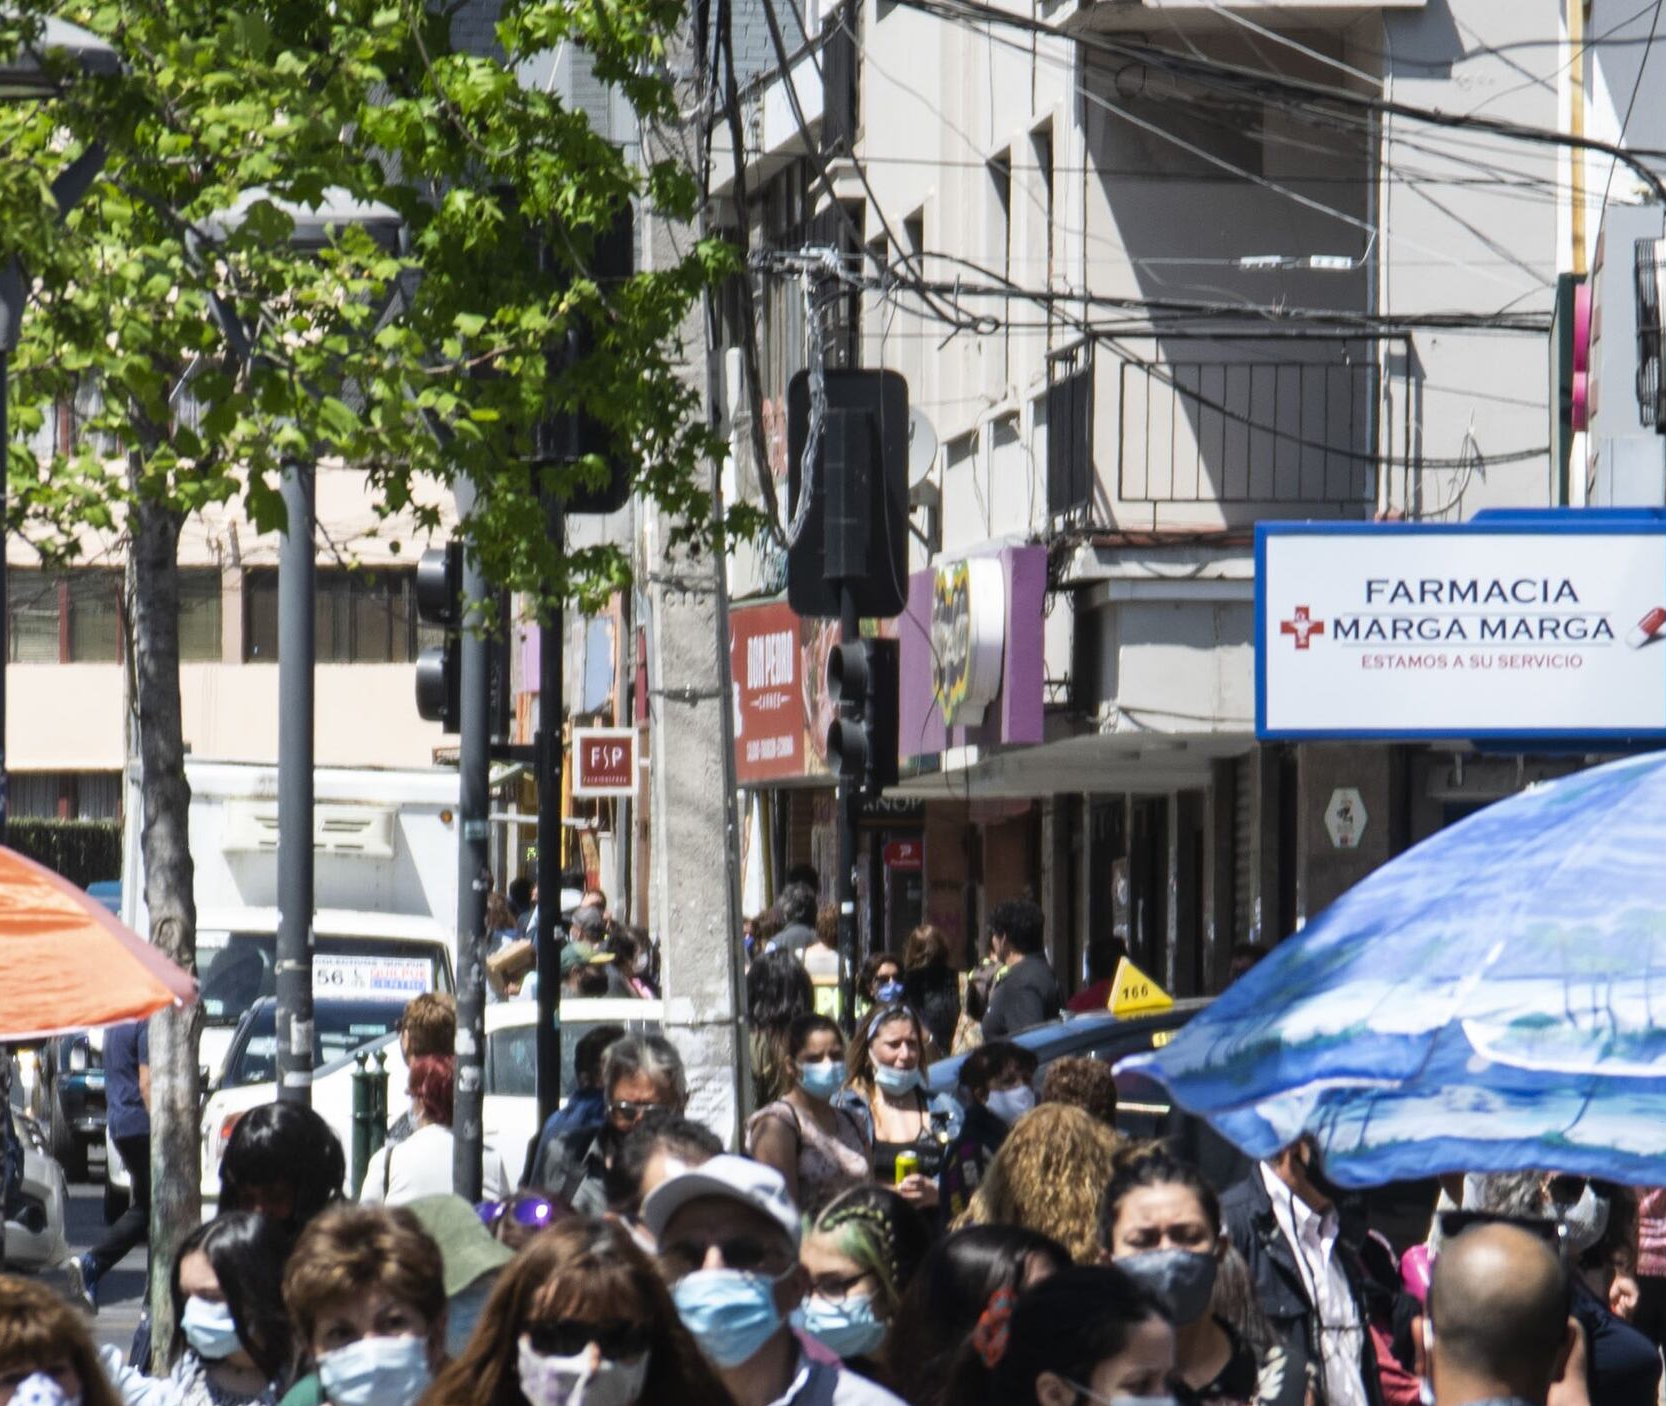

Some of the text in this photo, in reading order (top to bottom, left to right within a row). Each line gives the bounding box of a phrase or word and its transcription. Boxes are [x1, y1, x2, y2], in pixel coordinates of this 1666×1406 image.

[1365, 578, 1580, 604] FARMACIA
[1332, 617, 1615, 641] MARGA MARGA
[747, 629, 794, 690] DON PEDRO
[1361, 654, 1583, 669] ESTAMOS A SU SERVICIO
[317, 969, 344, 985] 56
[1122, 983, 1149, 1000] 166
